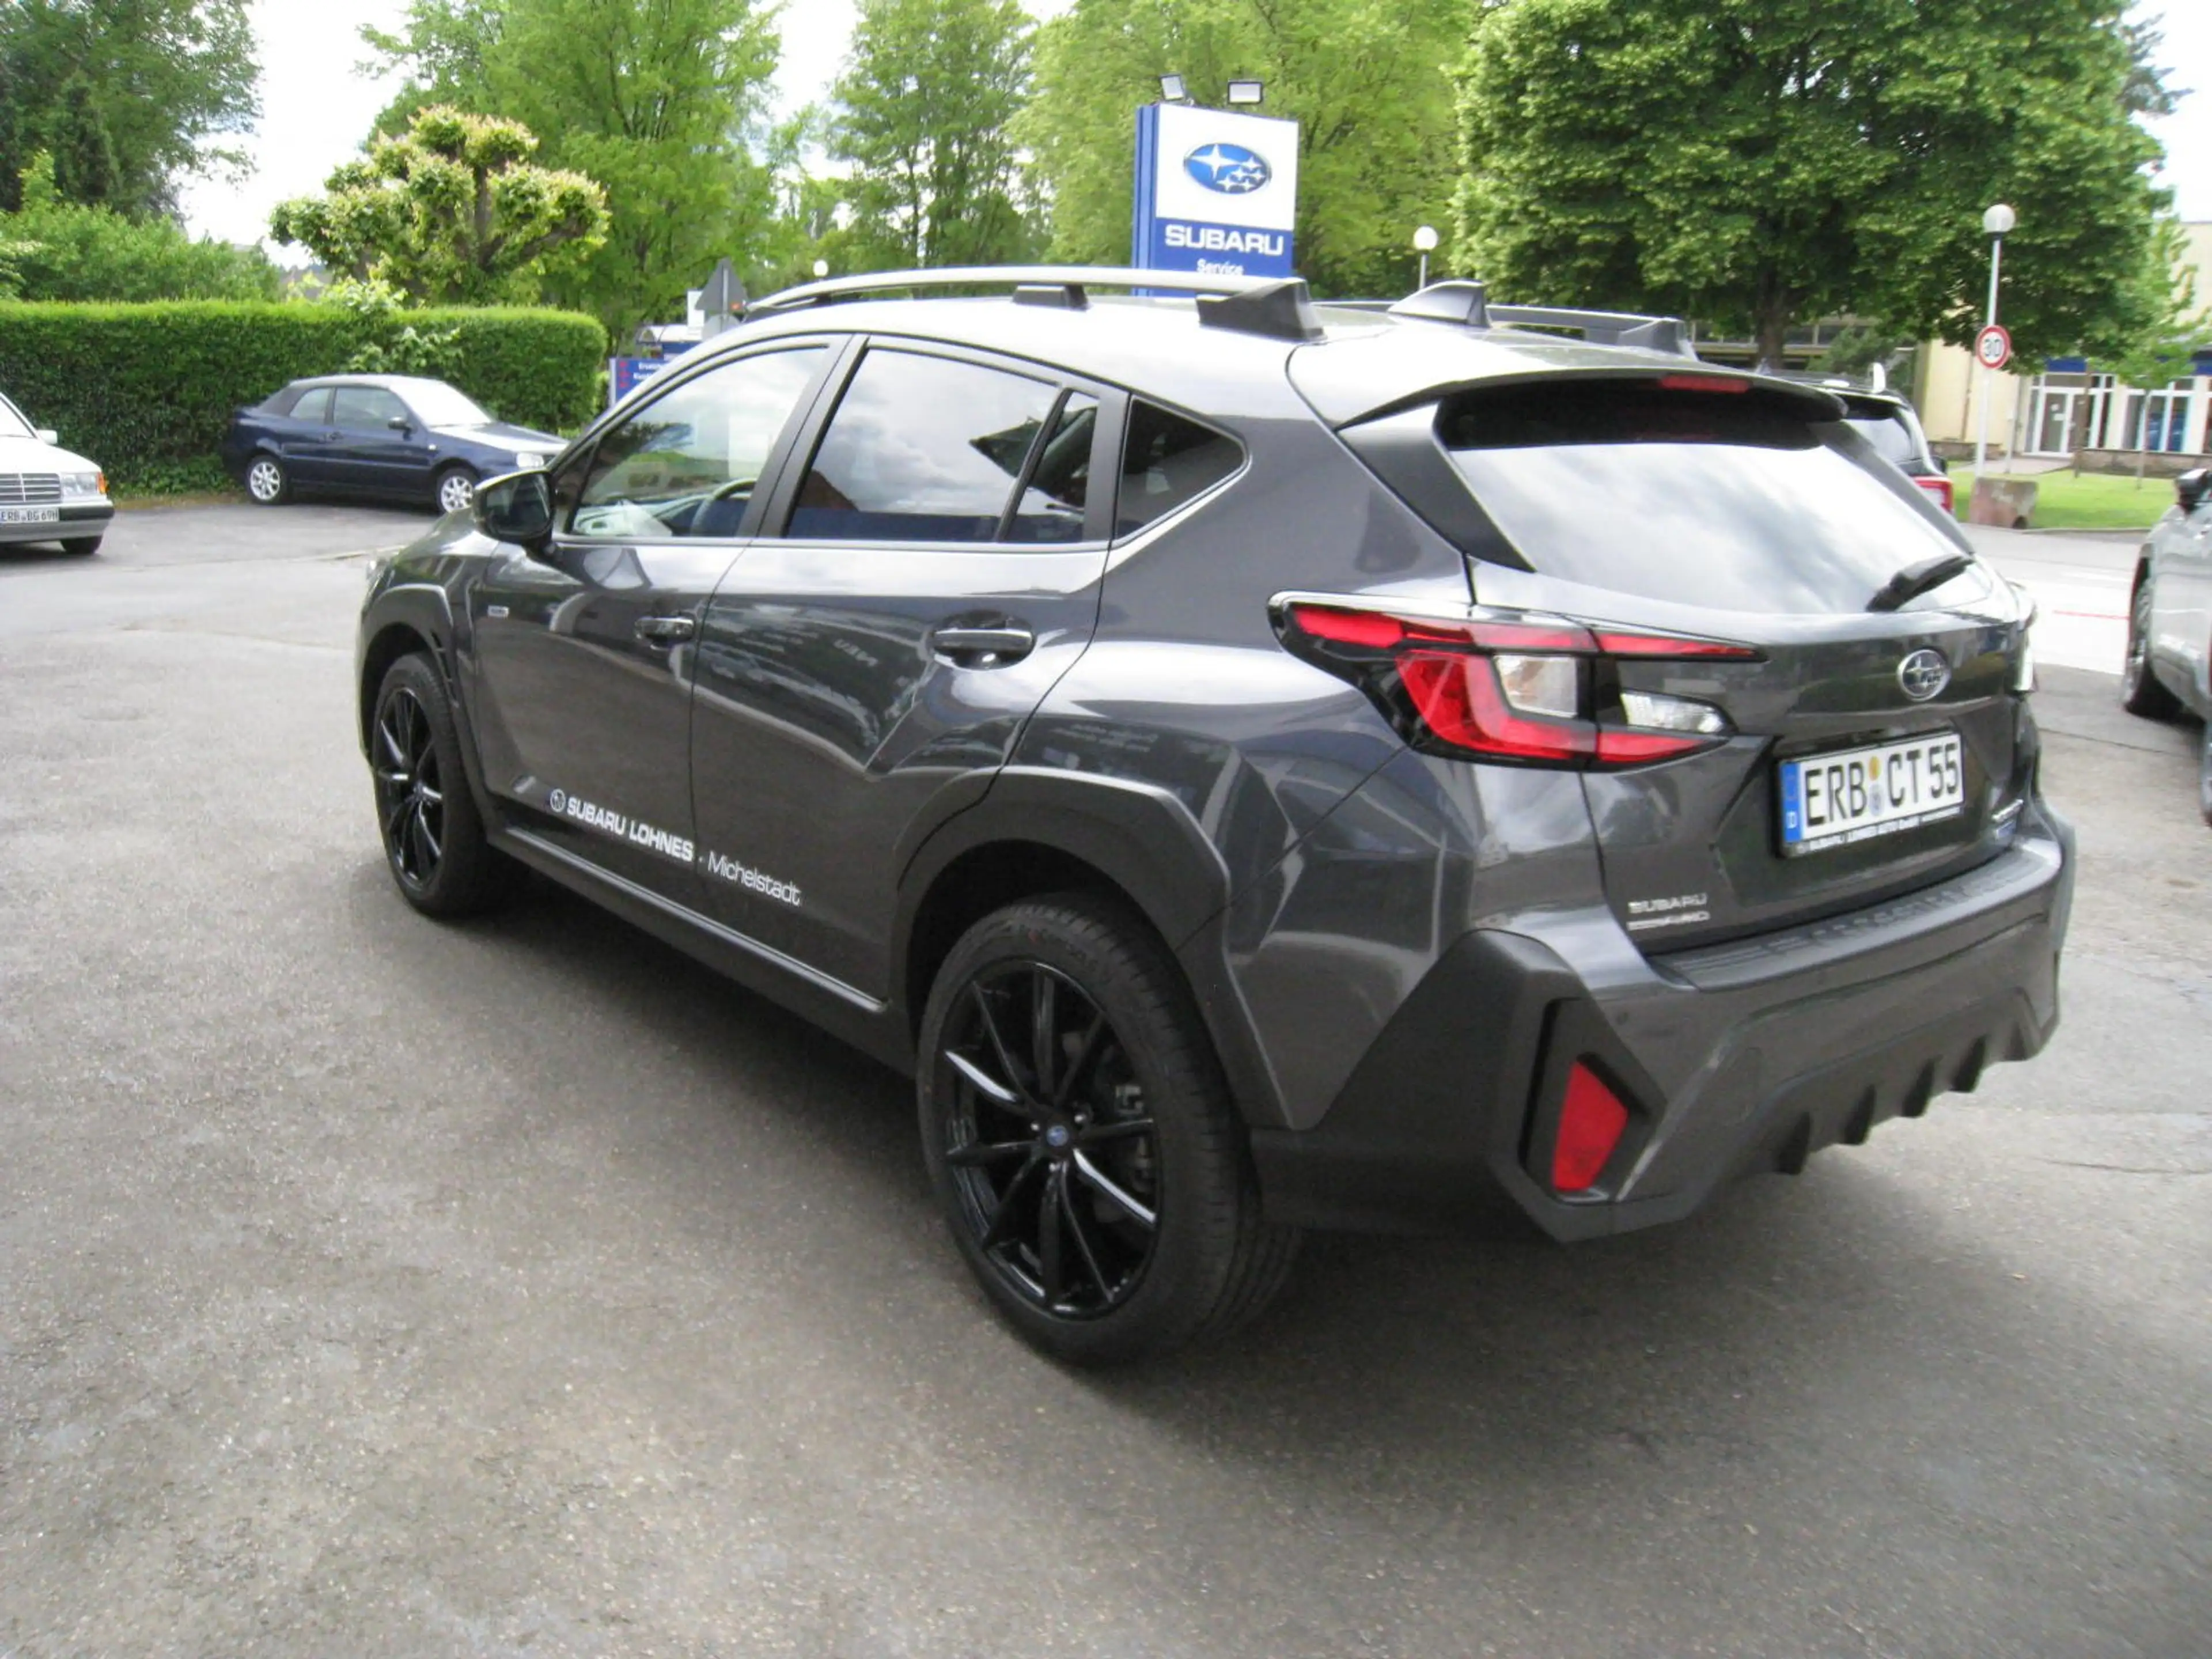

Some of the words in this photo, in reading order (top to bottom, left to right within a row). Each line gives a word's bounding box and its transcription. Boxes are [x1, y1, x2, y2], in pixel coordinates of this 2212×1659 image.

[1165, 224, 1284, 256] SUBARU
[1197, 258, 1244, 275] Service
[1984, 338, 2002, 357] 30
[1805, 760, 1868, 826] ERB
[1888, 749, 1922, 808] CT
[1929, 743, 1958, 798] 55
[1786, 811, 1797, 829] D
[567, 796, 626, 835] SUBARU
[629, 820, 694, 862] LOHNES
[707, 850, 802, 907] Michelstadt
[1628, 893, 1707, 914] SUBARU
